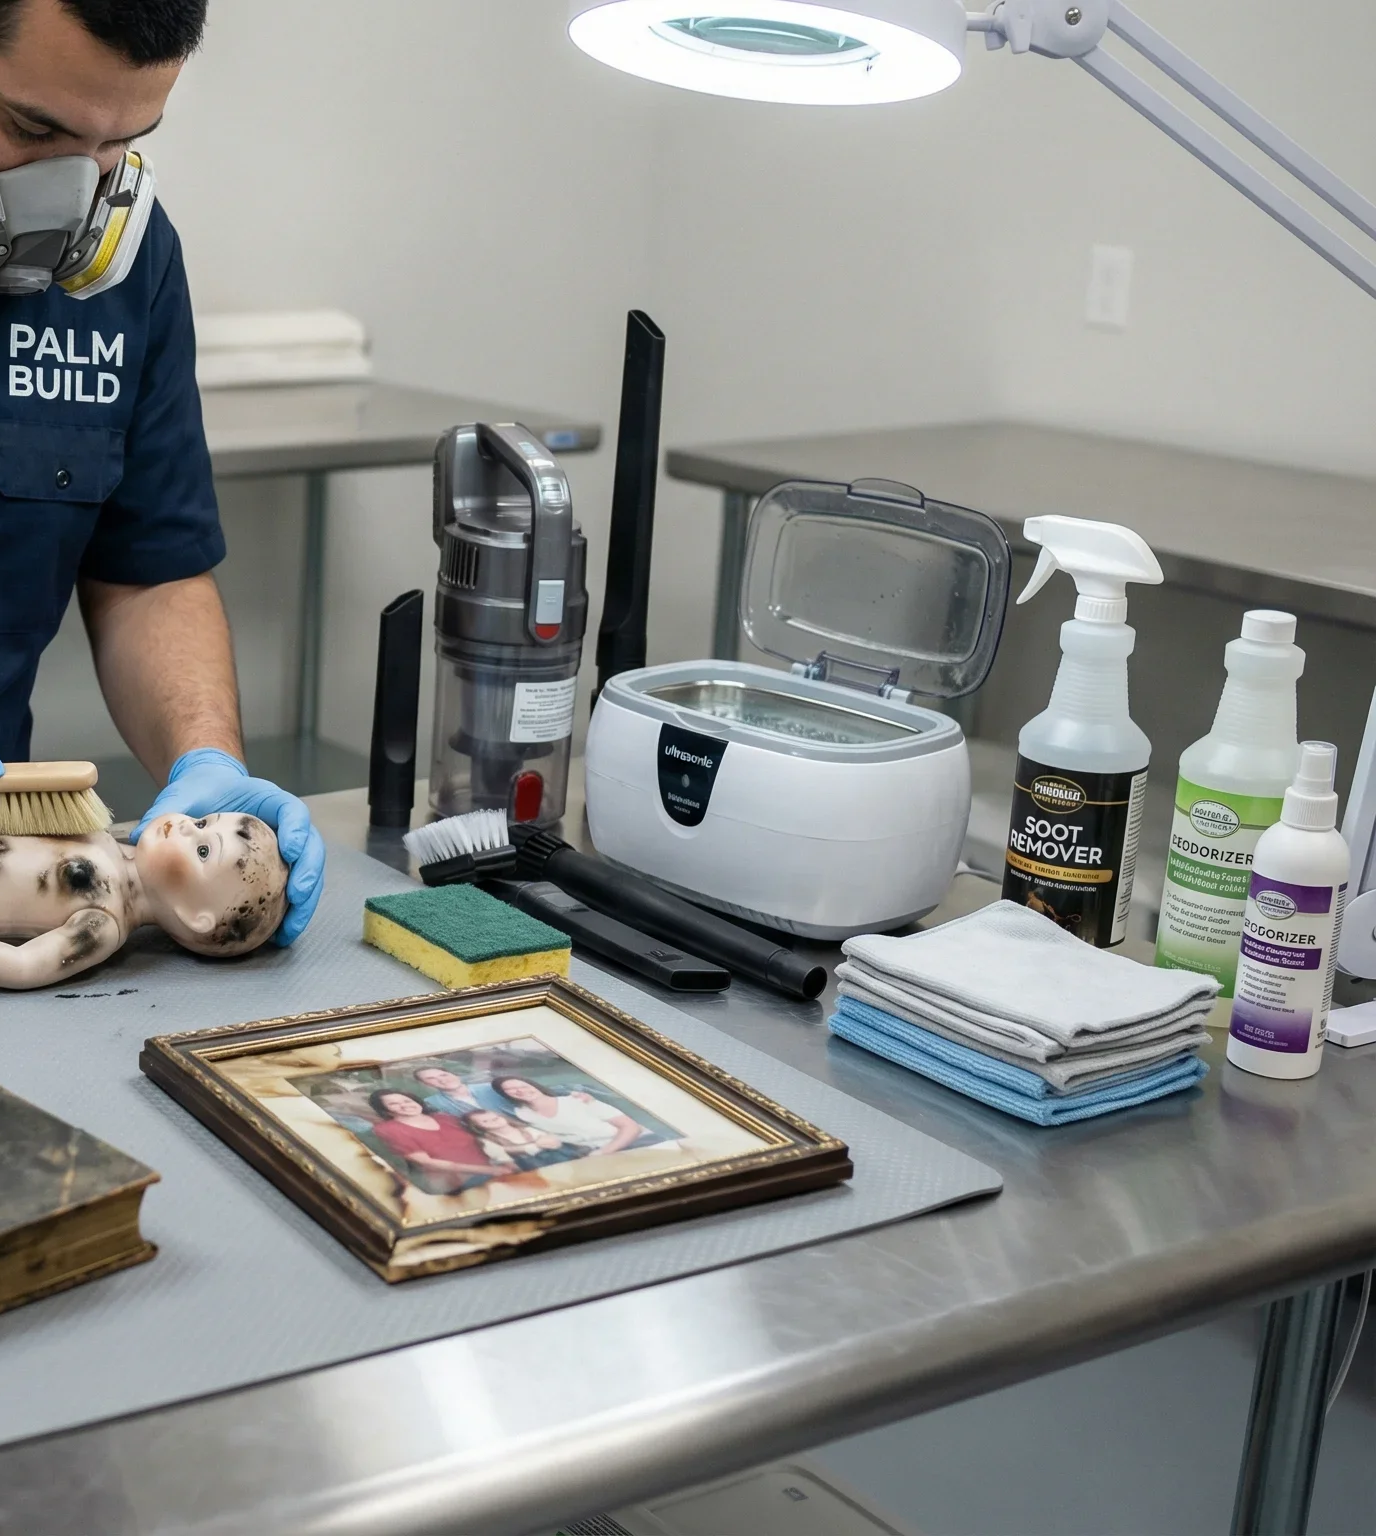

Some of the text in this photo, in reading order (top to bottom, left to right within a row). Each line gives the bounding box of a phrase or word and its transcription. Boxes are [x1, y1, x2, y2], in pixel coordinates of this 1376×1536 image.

[9, 322, 125, 367] PALM
[8, 364, 121, 404] BUILD
[1010, 828, 1103, 865] REMOVER
[1024, 815, 1084, 844] SOOT
